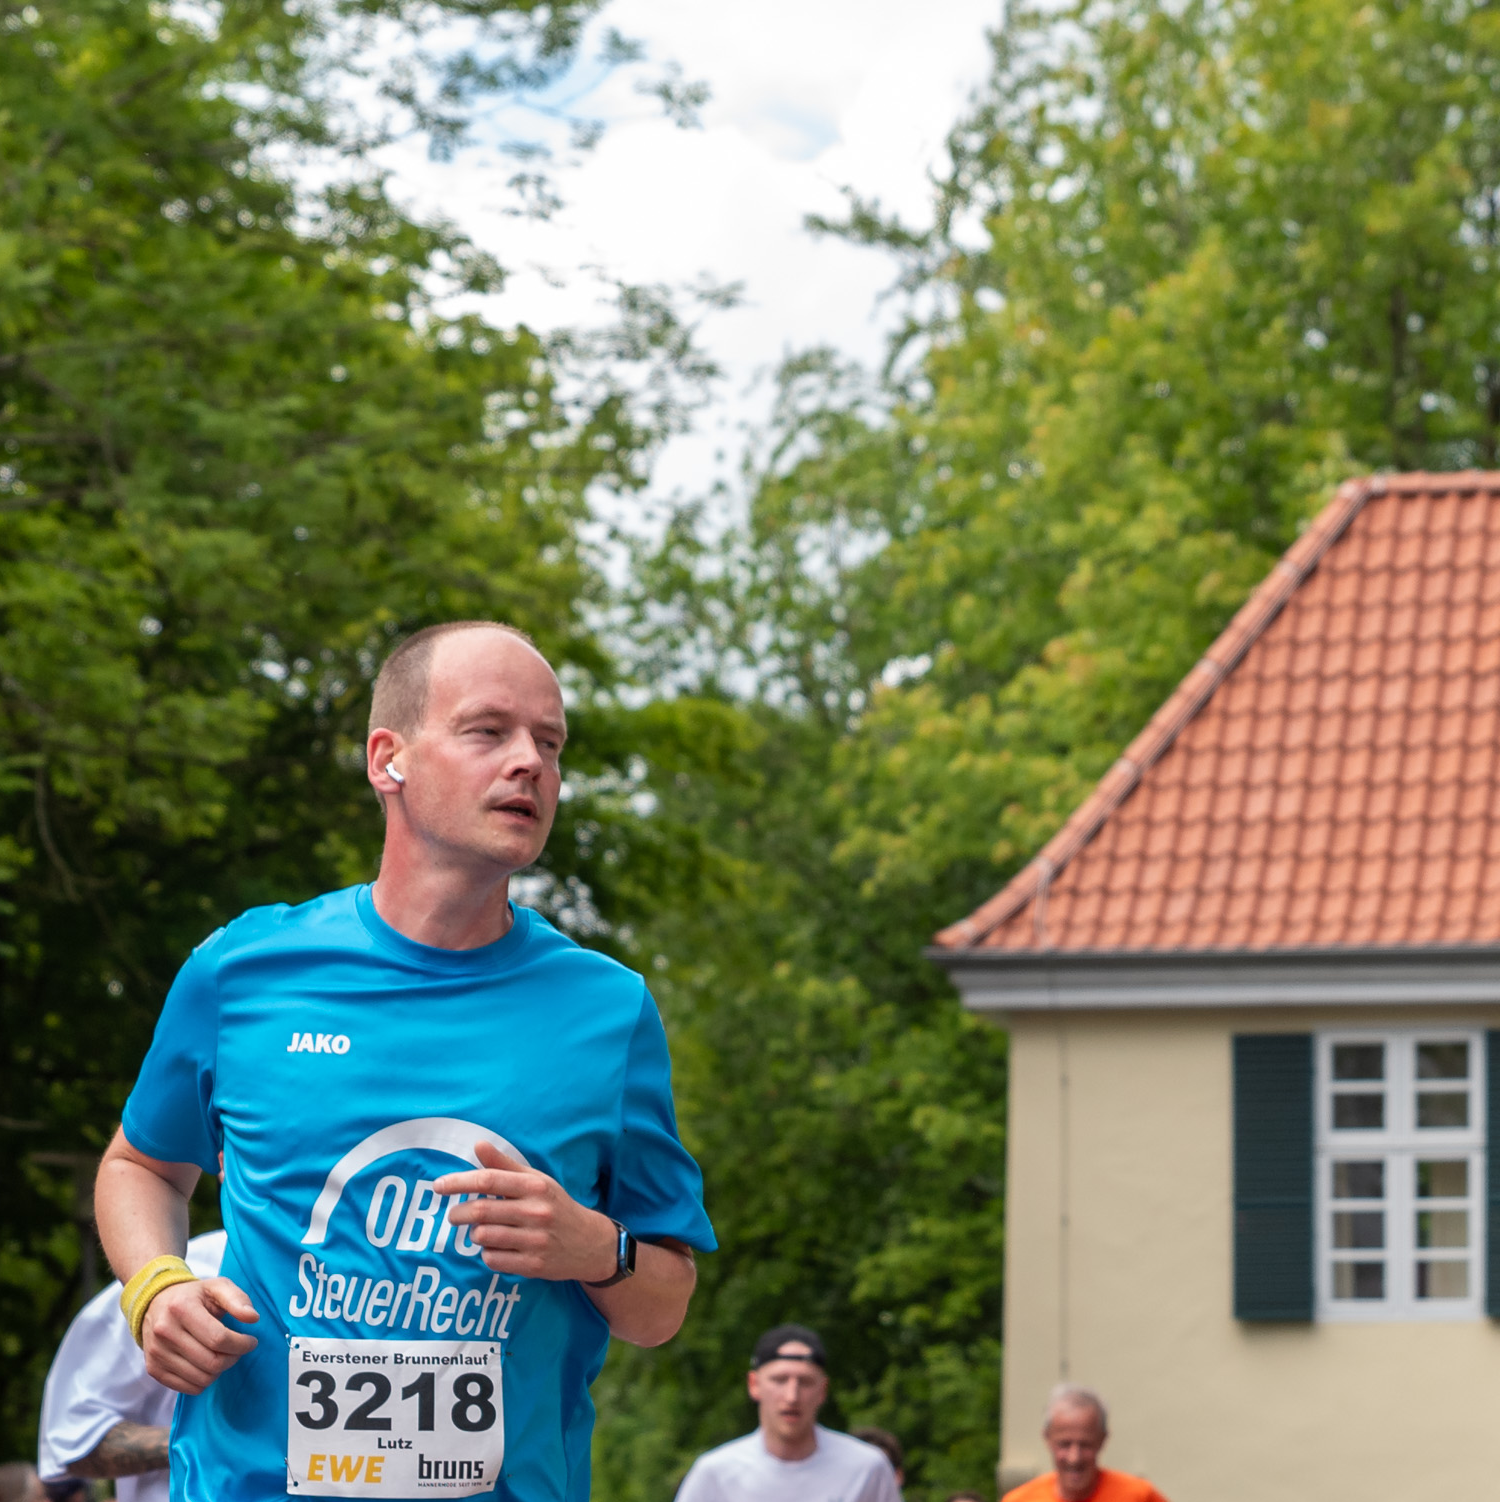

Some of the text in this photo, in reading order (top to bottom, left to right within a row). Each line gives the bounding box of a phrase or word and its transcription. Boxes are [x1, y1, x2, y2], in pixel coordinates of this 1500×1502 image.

[287, 1033, 350, 1054] JAKO
[289, 1253, 521, 1339] SteuerRecht
[302, 1351, 489, 1365] Everstener Brunnenlauf
[295, 1370, 497, 1432] 3218
[377, 1437, 413, 1450] Lutz
[307, 1454, 385, 1483] EWE
[418, 1453, 484, 1479] bruns
